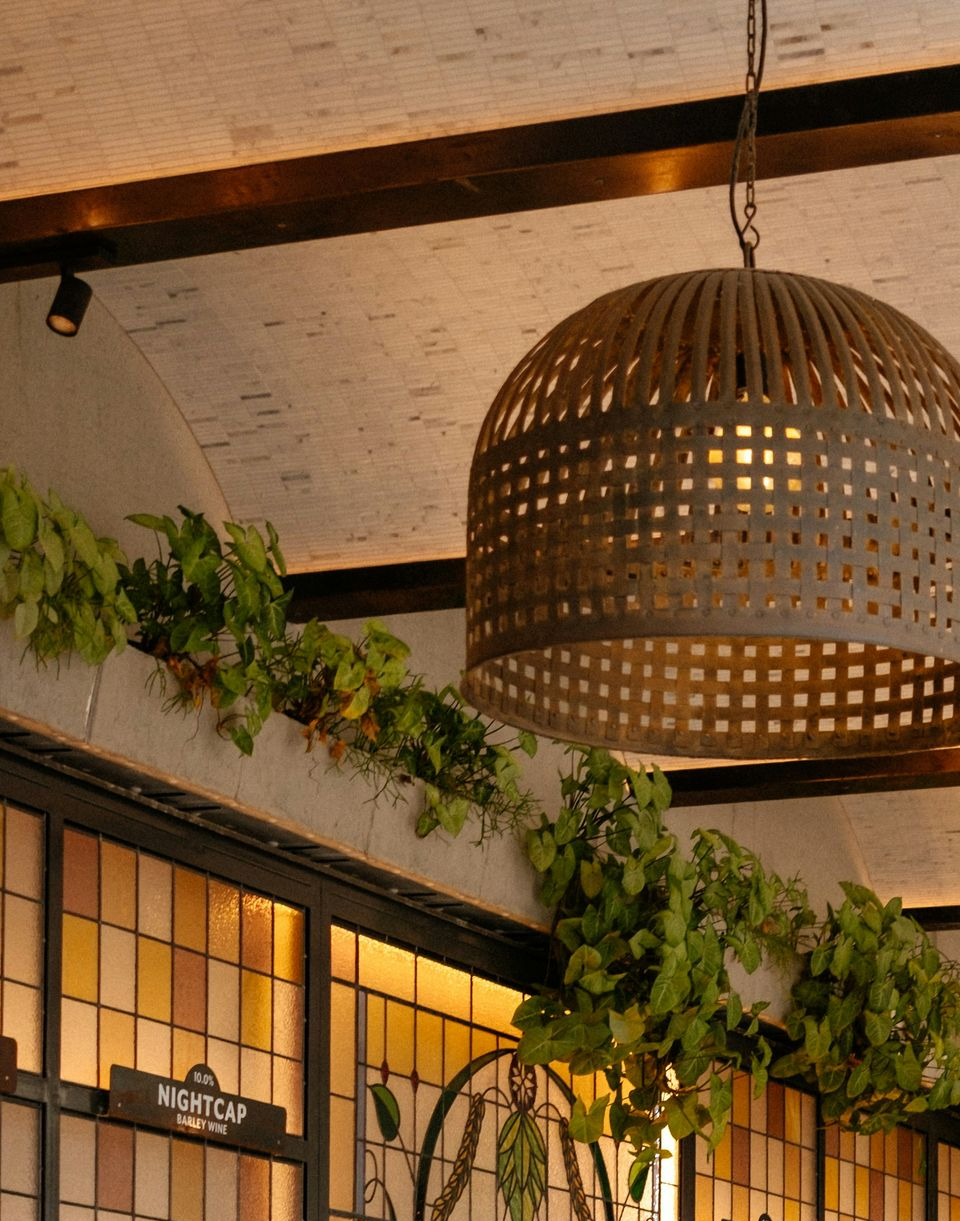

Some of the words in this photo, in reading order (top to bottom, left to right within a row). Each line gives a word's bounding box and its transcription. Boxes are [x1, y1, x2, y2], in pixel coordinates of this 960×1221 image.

[193, 1071, 215, 1087] 10.0%
[157, 1083, 247, 1125] NIGHTCAP
[176, 1113, 207, 1130] BARLEY
[207, 1121, 228, 1135] WINE
